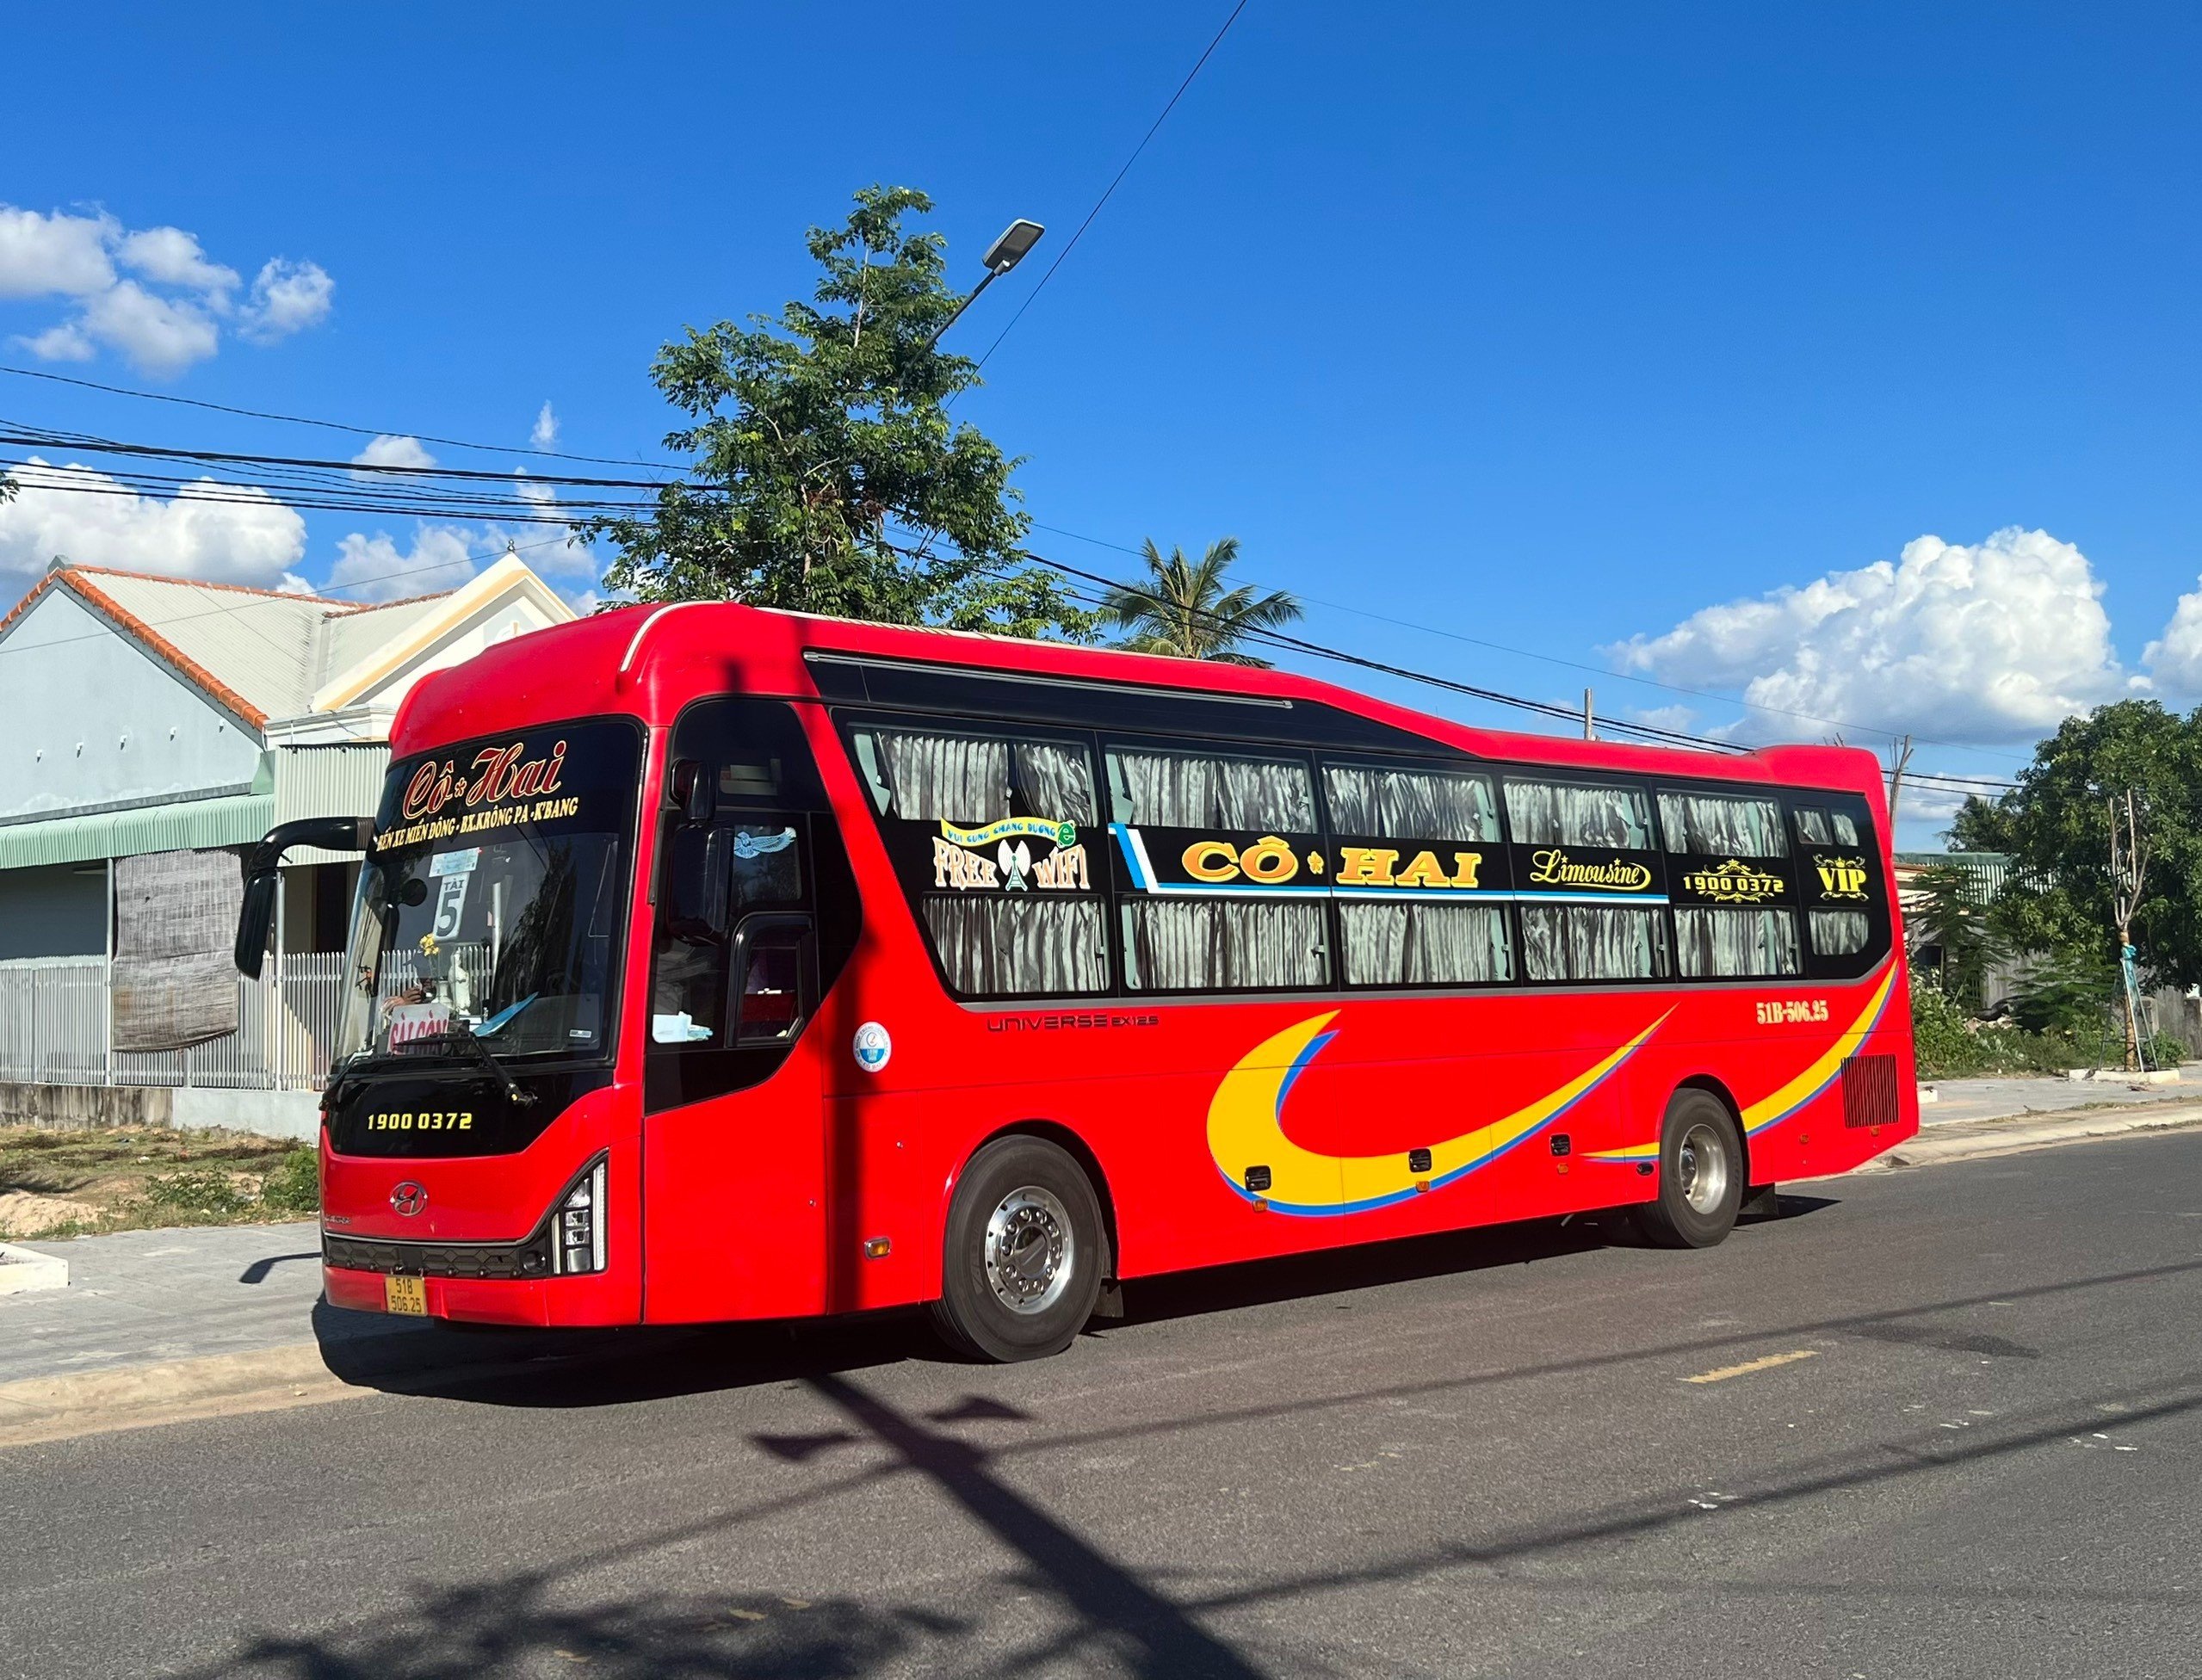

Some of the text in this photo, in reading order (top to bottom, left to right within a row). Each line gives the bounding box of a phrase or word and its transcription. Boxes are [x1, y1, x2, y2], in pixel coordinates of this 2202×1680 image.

[403, 740, 566, 820] Cô Hai
[393, 828, 406, 848] XE
[513, 804, 529, 824] PA
[932, 836, 1000, 891] FREE
[1181, 835, 1481, 887] CÔ HAI
[1530, 849, 1651, 891] Limousine
[1683, 875, 1784, 892] 1900 0372
[1816, 867, 1867, 892] VIP
[436, 890, 461, 936] 5
[987, 1014, 1108, 1032] UNIVERSE
[1756, 1000, 1829, 1024] 51B-506.25
[368, 1113, 472, 1130] 1900 0372
[395, 1278, 413, 1294] 51B
[391, 1295, 422, 1312] 506.25
